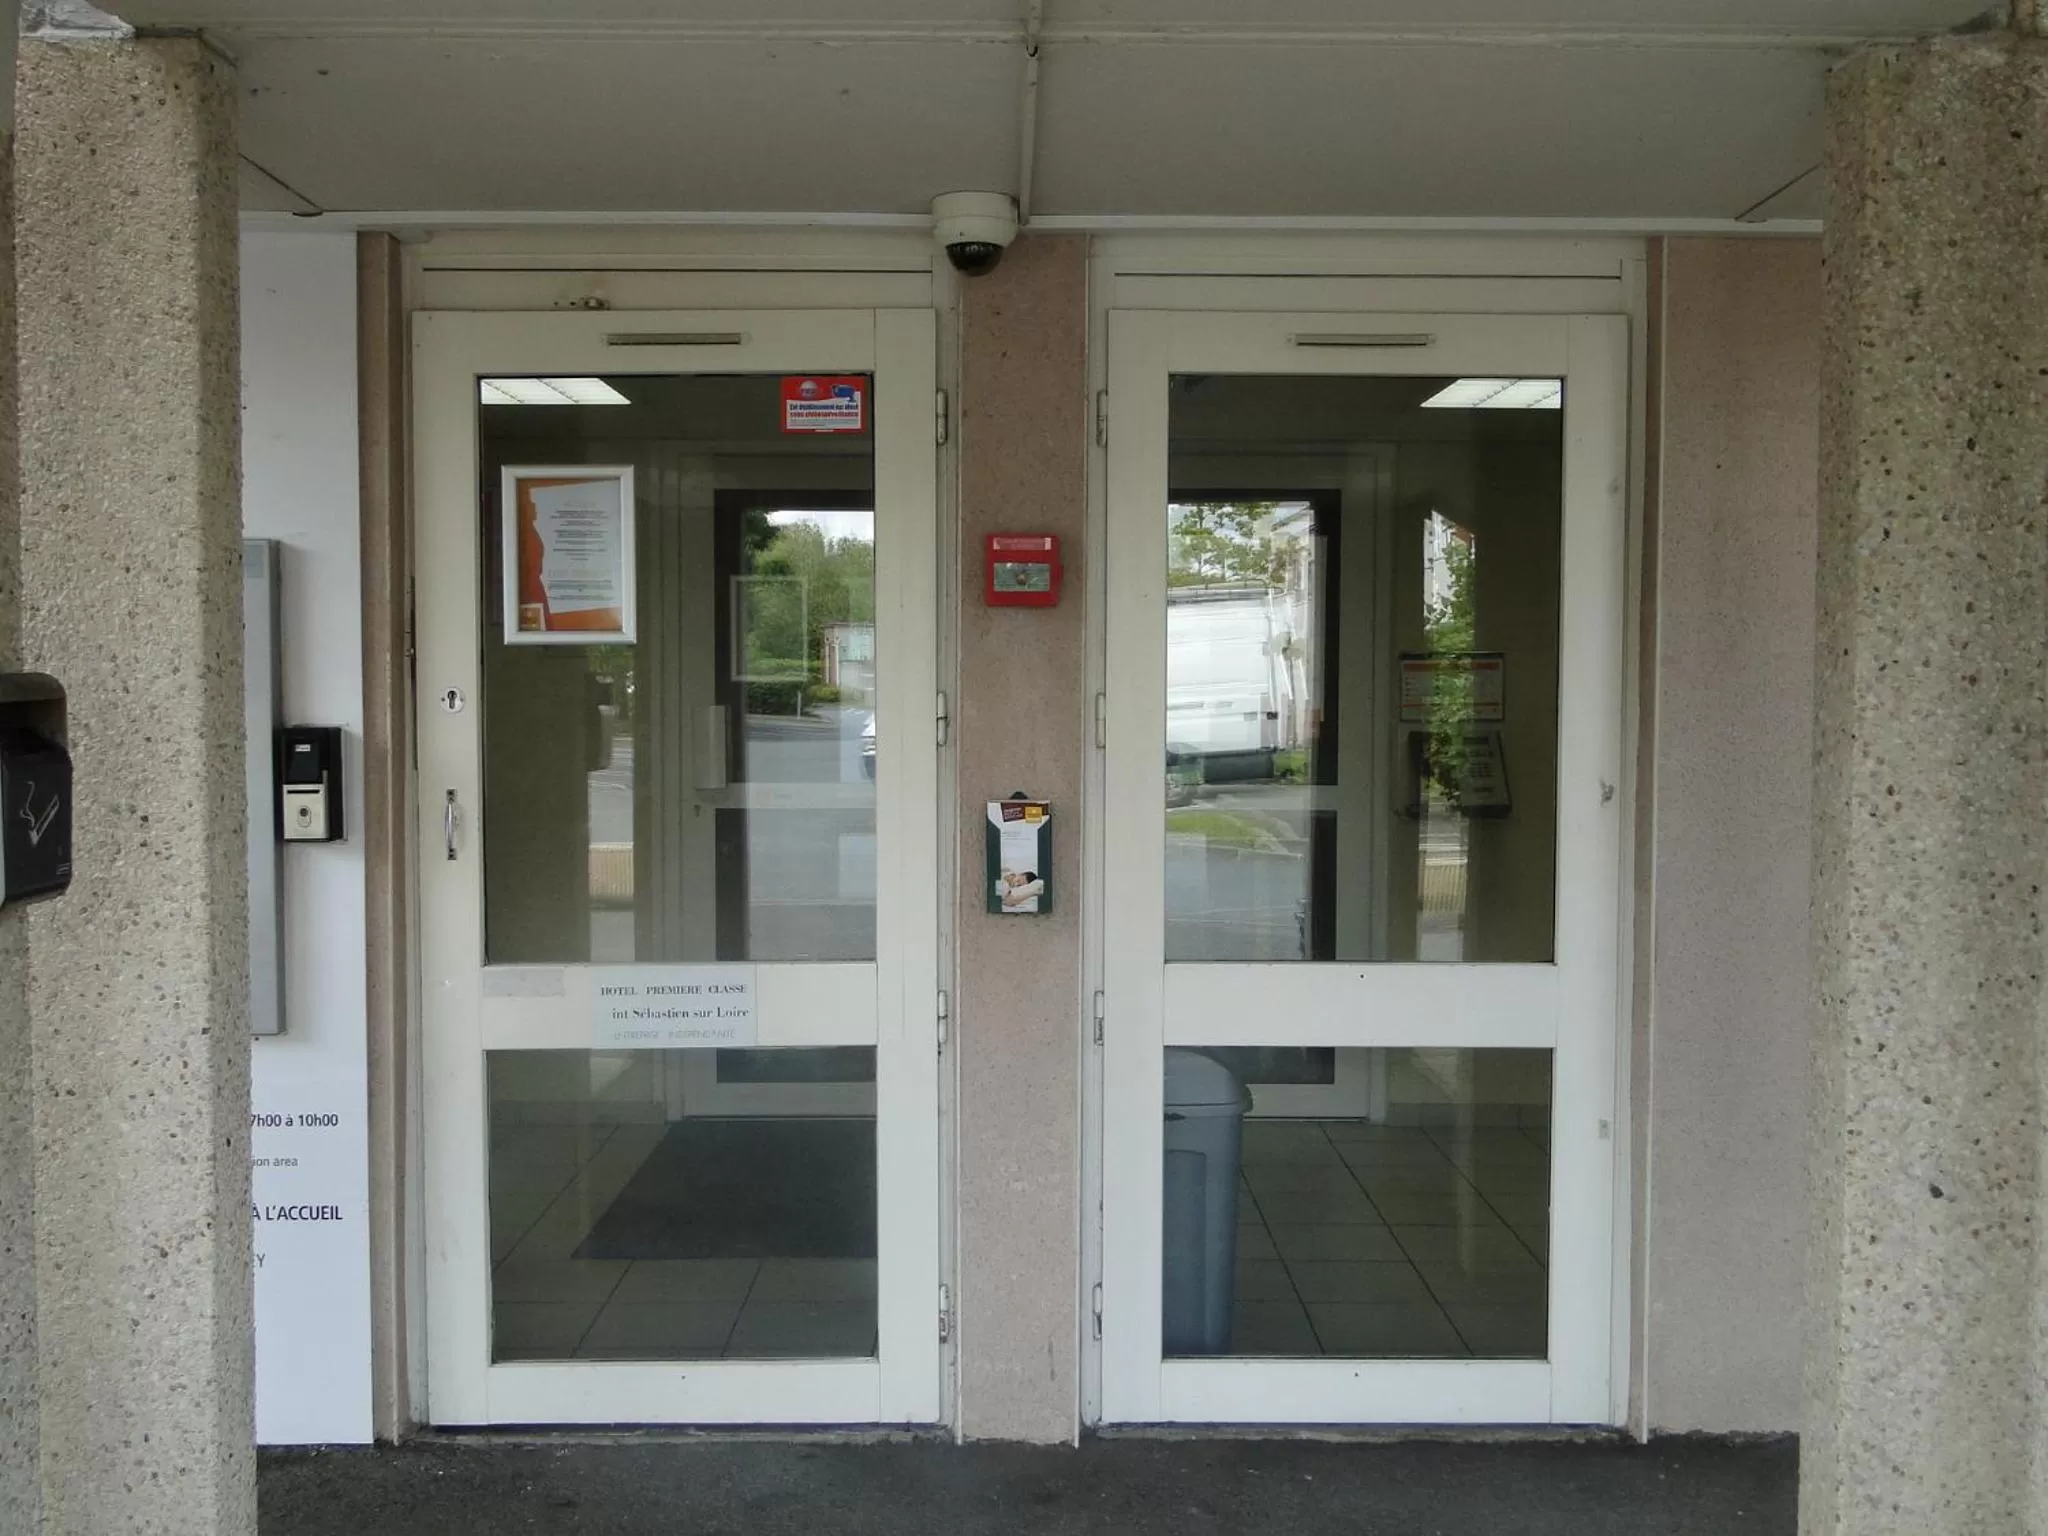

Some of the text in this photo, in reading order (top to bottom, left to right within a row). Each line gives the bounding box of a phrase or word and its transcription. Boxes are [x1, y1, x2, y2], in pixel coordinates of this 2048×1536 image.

[600, 984, 748, 996] HOTEL PREMIERE CLASSE
[633, 1005, 690, 1019] Sébastien
[693, 1008, 713, 1018] sur
[717, 1006, 749, 1018] Loire
[250, 1114, 339, 1127] 7h00 à 10h00
[273, 1157, 299, 1167] area
[265, 1205, 343, 1221] L'ACCUEIL
